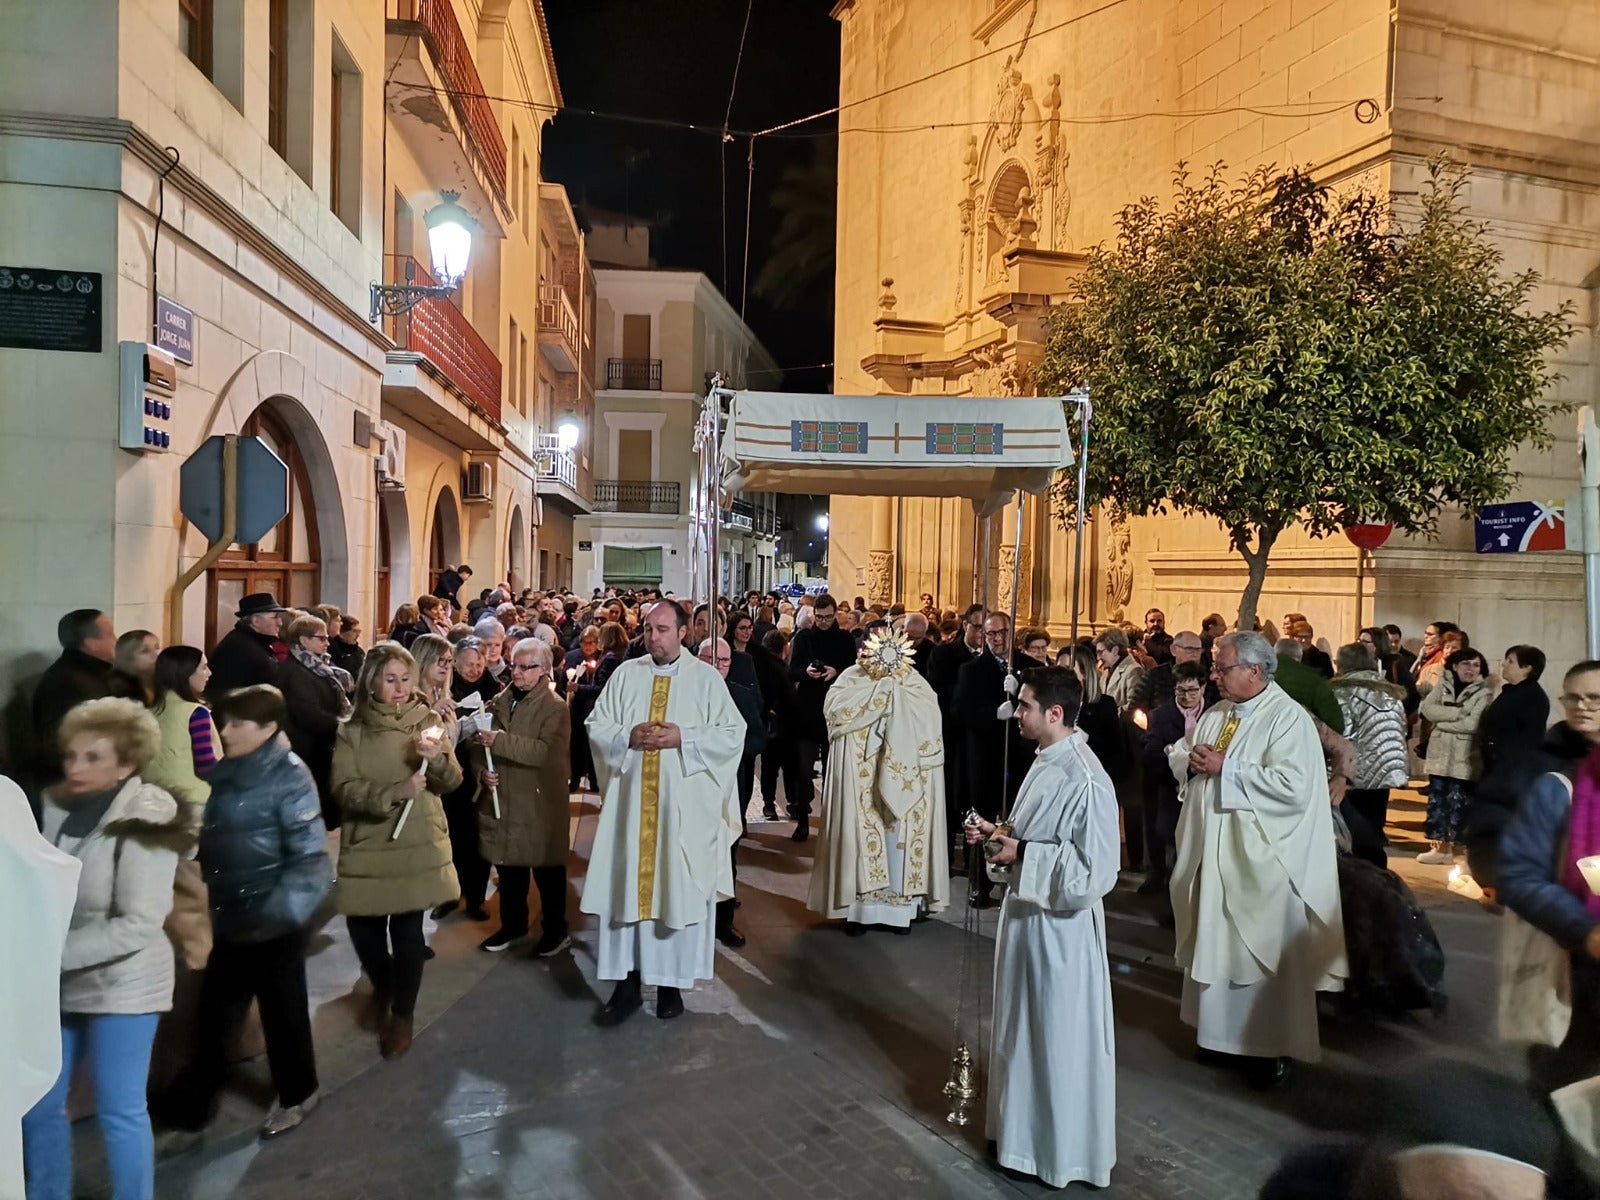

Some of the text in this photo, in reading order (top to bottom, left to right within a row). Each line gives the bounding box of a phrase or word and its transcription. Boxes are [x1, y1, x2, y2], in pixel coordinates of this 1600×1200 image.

[165, 311, 187, 331] CARRER
[160, 328, 191, 351] JORGE JUAN
